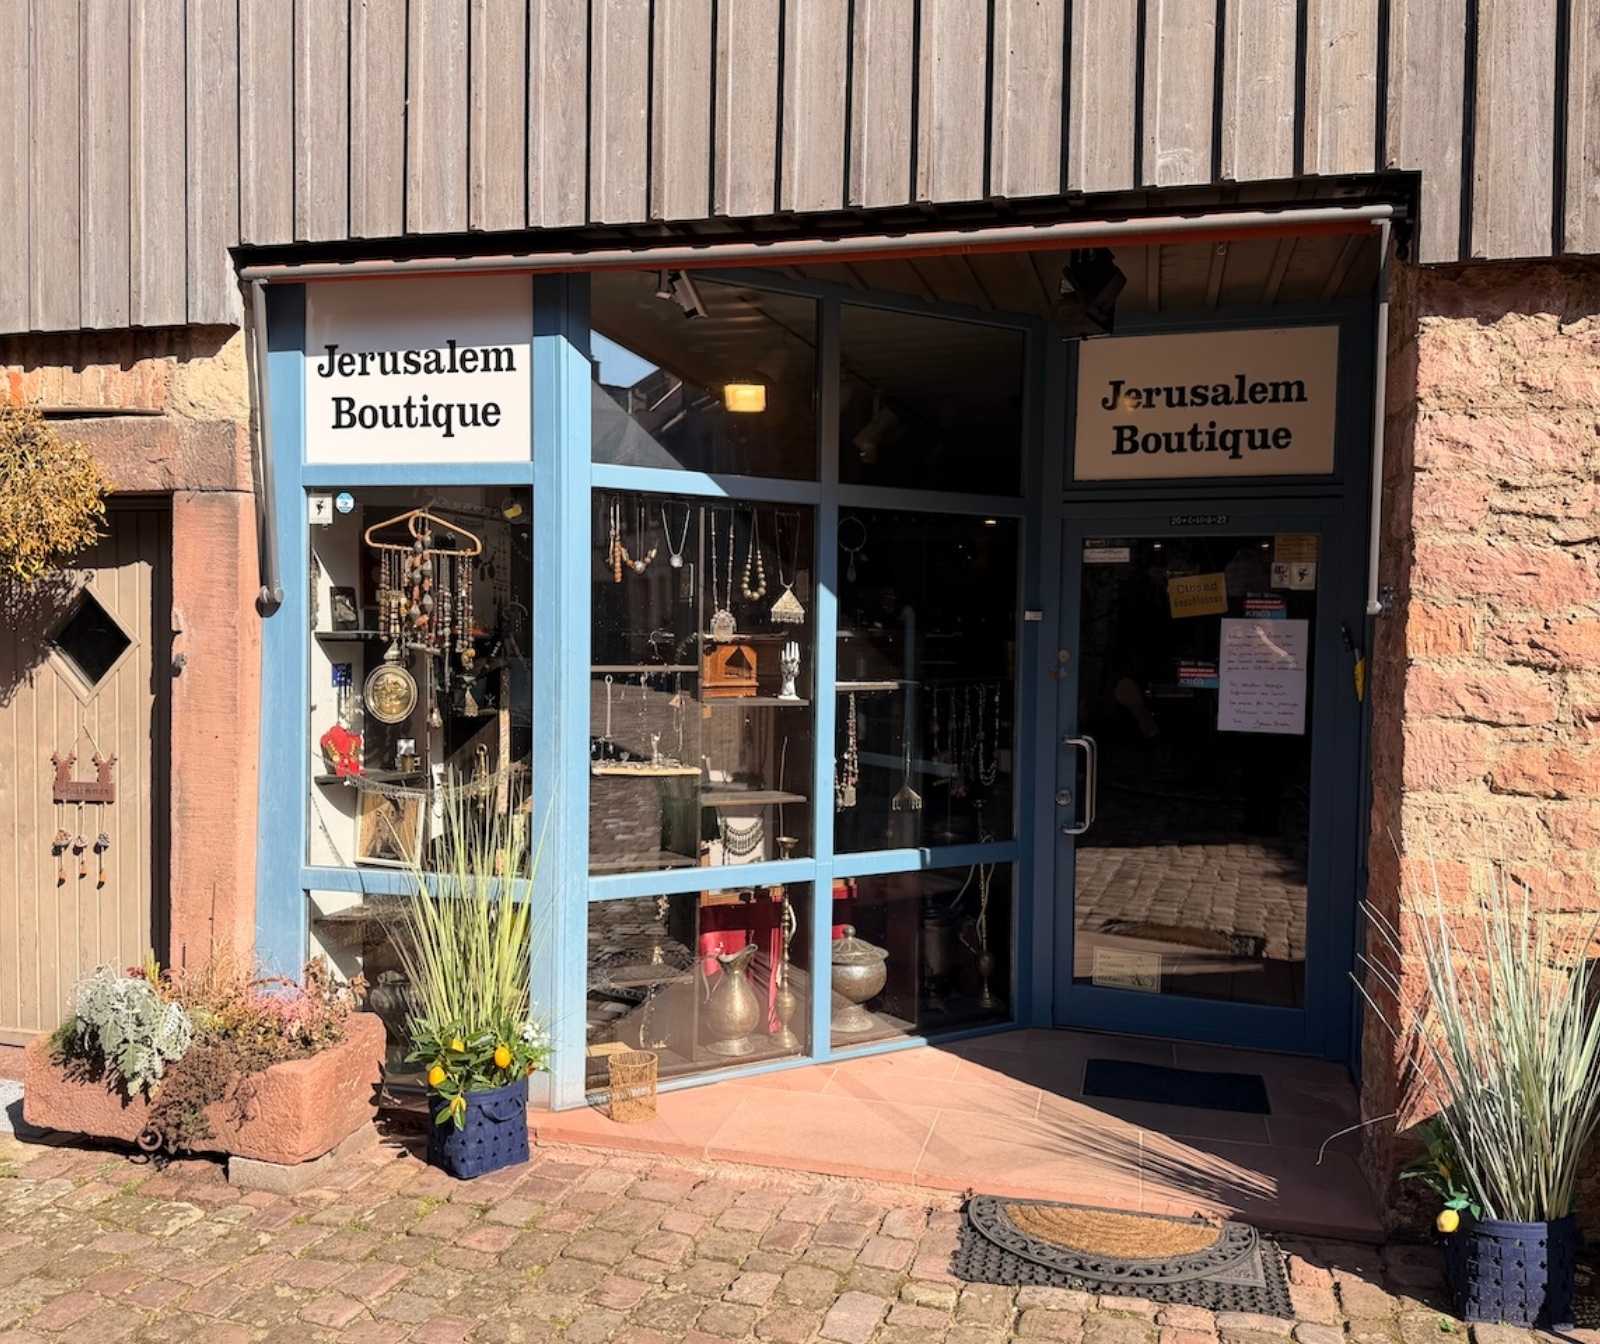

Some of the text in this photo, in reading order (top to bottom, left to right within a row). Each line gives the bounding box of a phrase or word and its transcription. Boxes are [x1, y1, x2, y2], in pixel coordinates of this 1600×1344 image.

[317, 340, 516, 378] Jerusalem
[1101, 374, 1308, 411] Jerusalem
[331, 394, 501, 438] Boutique
[1111, 420, 1293, 460] Boutique
